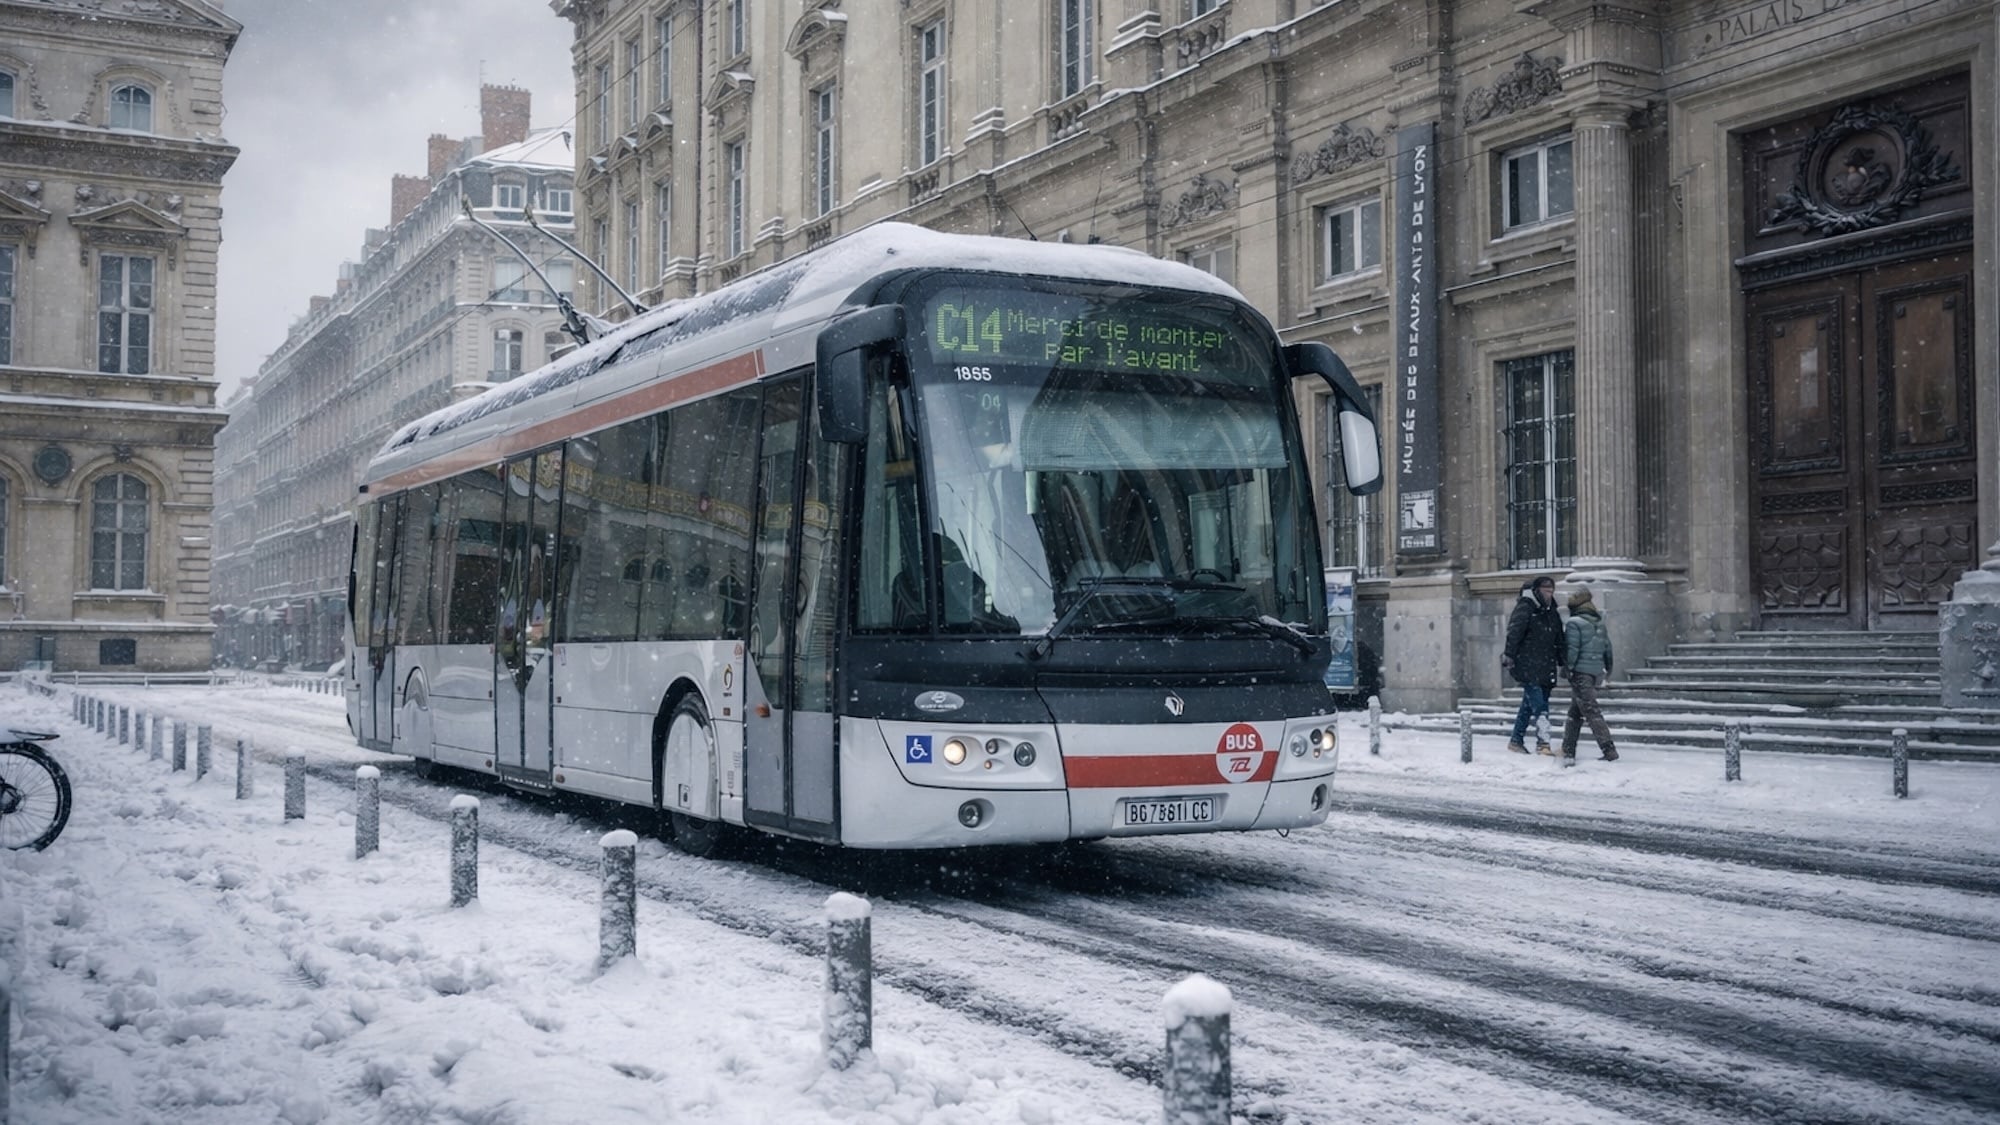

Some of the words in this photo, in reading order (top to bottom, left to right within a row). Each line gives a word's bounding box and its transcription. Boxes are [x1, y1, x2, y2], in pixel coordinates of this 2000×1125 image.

[1718, 0, 1804, 42] PALAIS
[1413, 144, 1427, 195] LYON
[1412, 200, 1424, 226] DE
[936, 303, 1004, 353] C14
[1007, 309, 1085, 338] Merci
[1099, 319, 1129, 341] de
[1140, 325, 1227, 349] monter
[1106, 341, 1201, 372] l'avant
[1225, 733, 1257, 750] BUS
